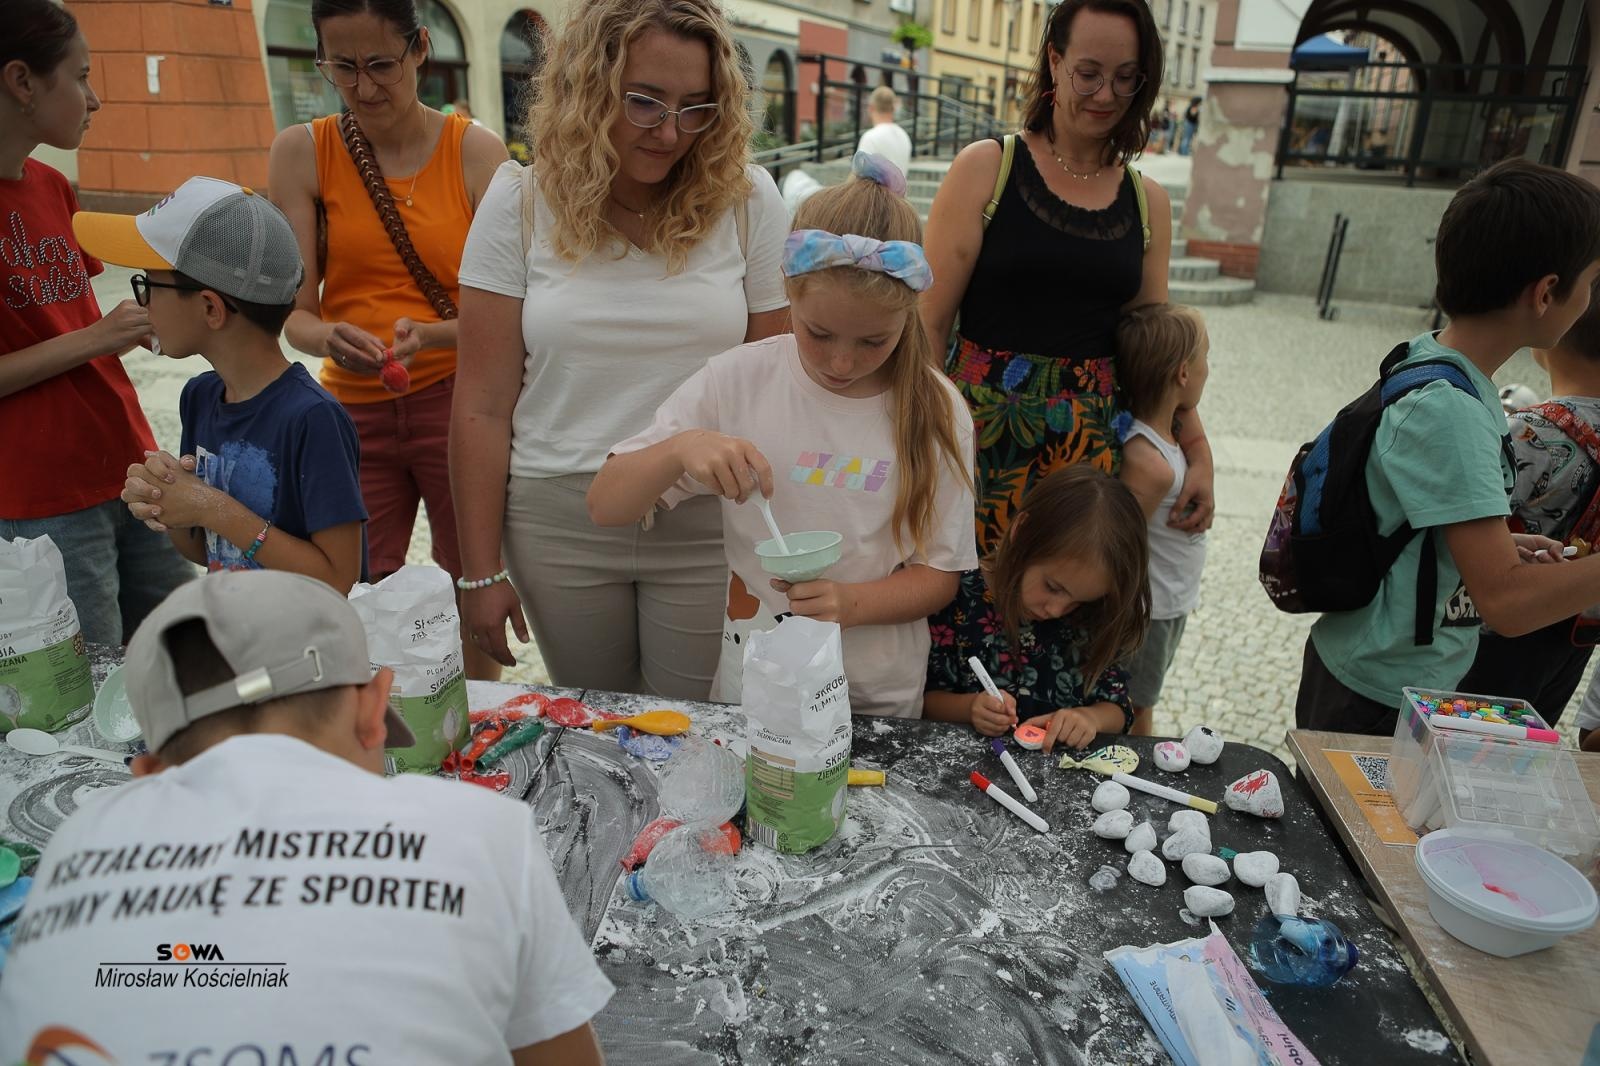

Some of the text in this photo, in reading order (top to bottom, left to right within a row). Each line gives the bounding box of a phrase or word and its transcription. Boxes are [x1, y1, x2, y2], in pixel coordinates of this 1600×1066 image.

[0, 655, 27, 668] ZANA
[234, 822, 425, 861] MISTRZÓW
[111, 874, 232, 916] NAUKĘ
[243, 876, 287, 907] ZE
[300, 875, 464, 917] SPORTEM
